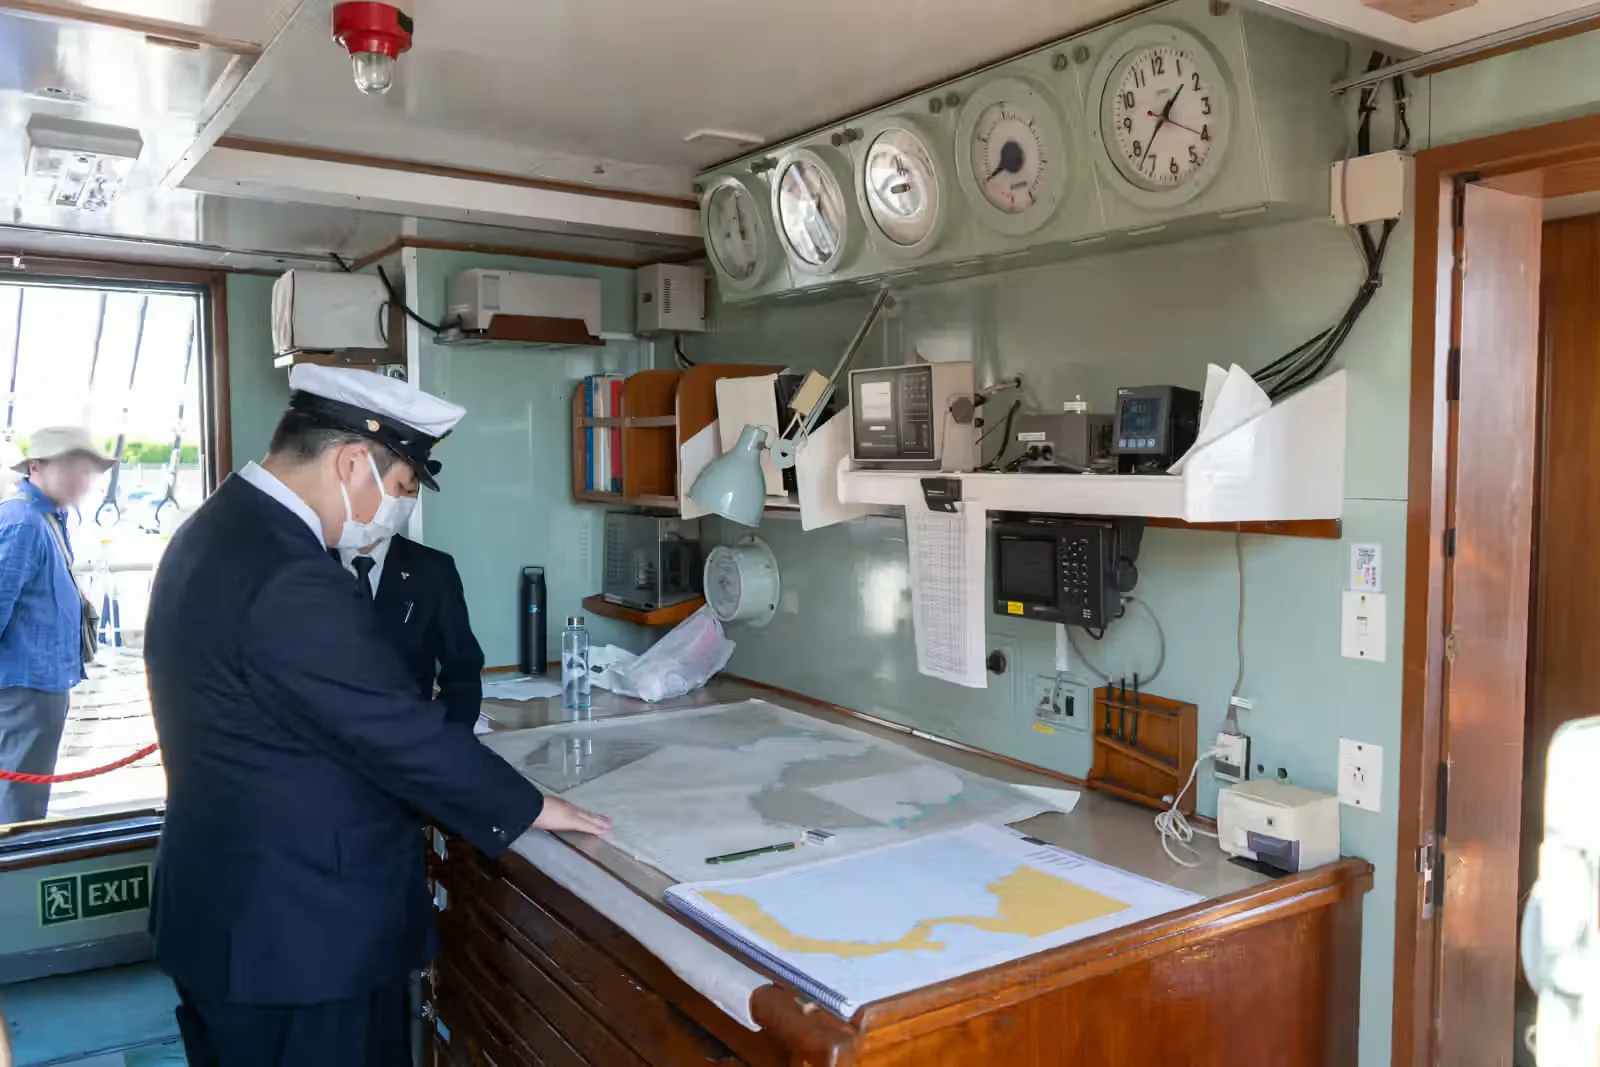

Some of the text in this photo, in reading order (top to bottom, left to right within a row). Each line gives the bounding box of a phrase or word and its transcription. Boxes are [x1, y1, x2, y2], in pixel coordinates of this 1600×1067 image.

[1151, 56, 1165, 76] 12
[1176, 59, 1182, 77] 1
[1134, 68, 1146, 89] 11
[1192, 72, 1201, 91] 2
[1123, 91, 1135, 111] 10
[1201, 97, 1211, 115] 3
[1123, 117, 1132, 135] 9
[1201, 124, 1209, 141] 4
[1132, 140, 1142, 157] 8
[1188, 146, 1198, 164] 5
[1148, 154, 1157, 173] 7
[1169, 157, 1179, 174] 6
[88, 877, 144, 906] EXIT
